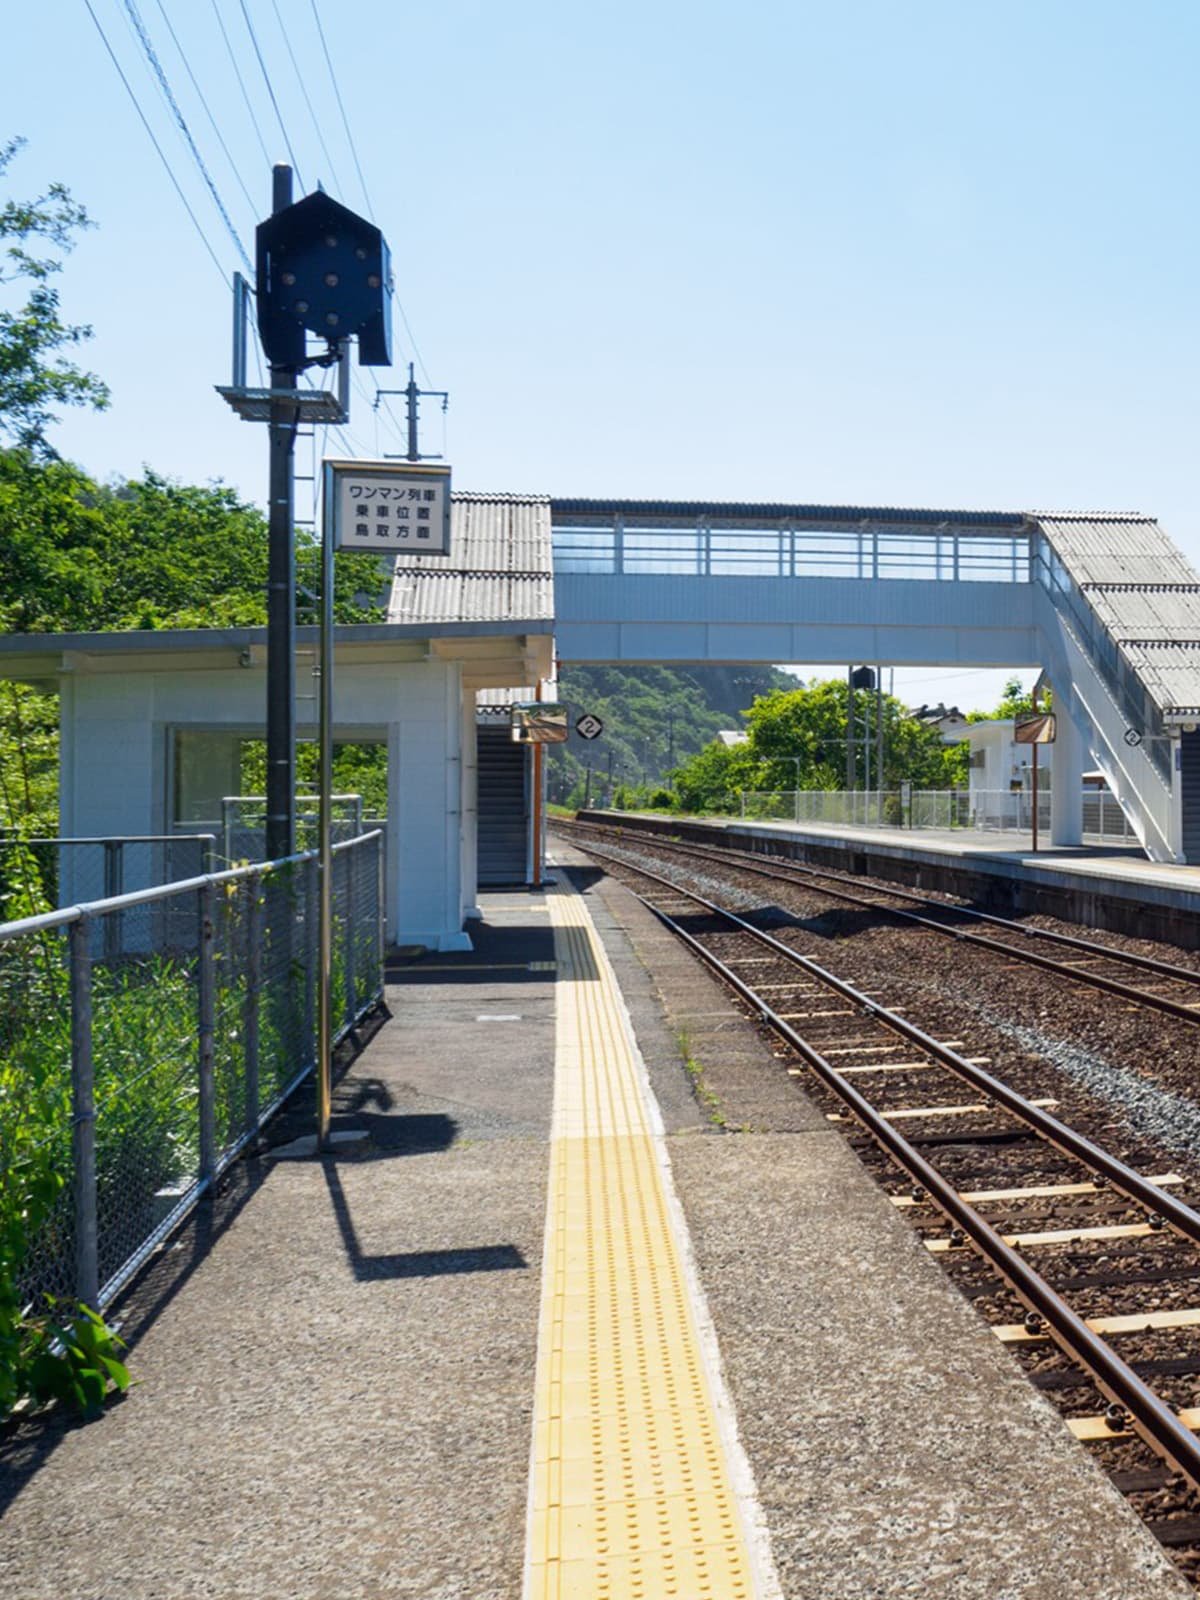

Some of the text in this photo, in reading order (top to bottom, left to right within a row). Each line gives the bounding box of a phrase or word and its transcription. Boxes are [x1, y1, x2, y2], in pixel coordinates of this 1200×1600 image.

[349, 486, 436, 502] ワンマン列車
[355, 504, 430, 520] 乗車位置
[355, 523, 430, 539] 鳥取方面
[585, 720, 595, 734] 2
